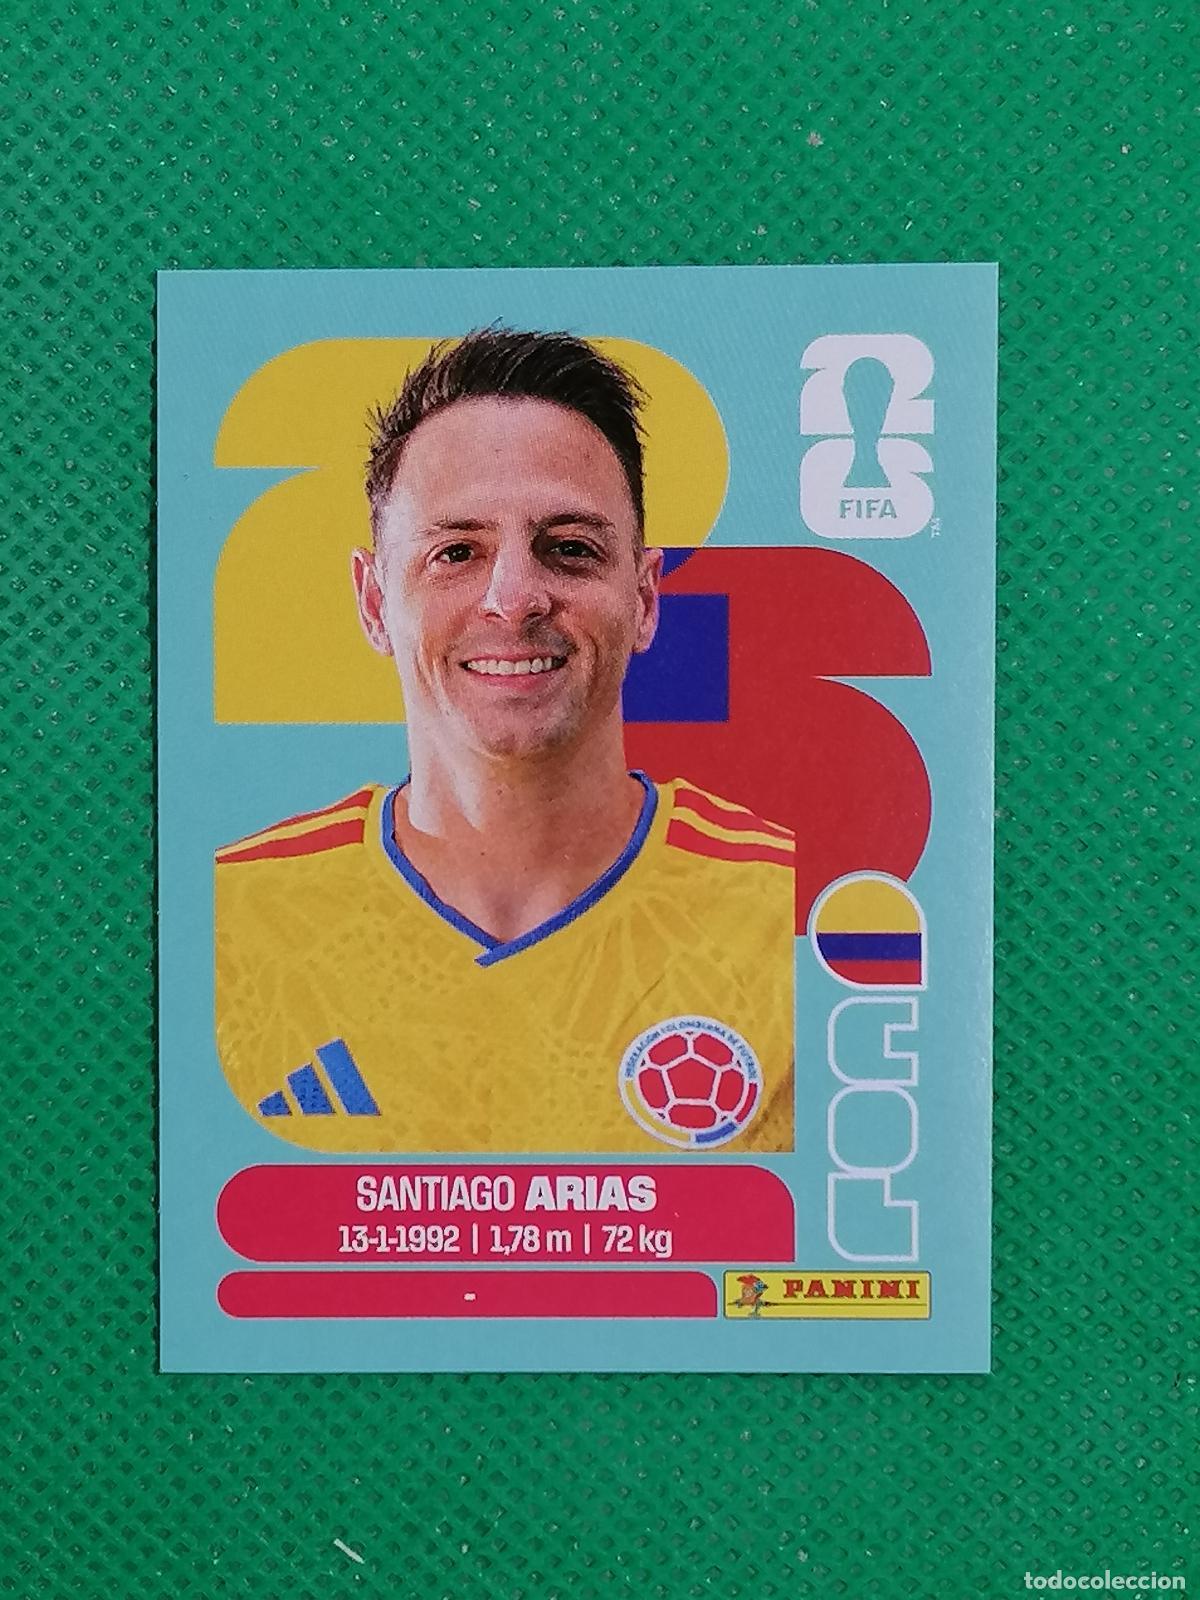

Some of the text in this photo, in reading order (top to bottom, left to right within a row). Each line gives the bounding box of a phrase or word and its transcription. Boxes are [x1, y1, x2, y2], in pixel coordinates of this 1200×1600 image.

[839, 499, 897, 519] FIFA
[356, 1175, 658, 1212] SANTIAGO ARIAS
[338, 1224, 461, 1253] 13-1-1992
[489, 1224, 541, 1256] 1,78
[546, 1228, 572, 1253] m
[601, 1225, 634, 1253] 72
[638, 1224, 673, 1258] kg
[782, 1279, 921, 1299] PANINI
